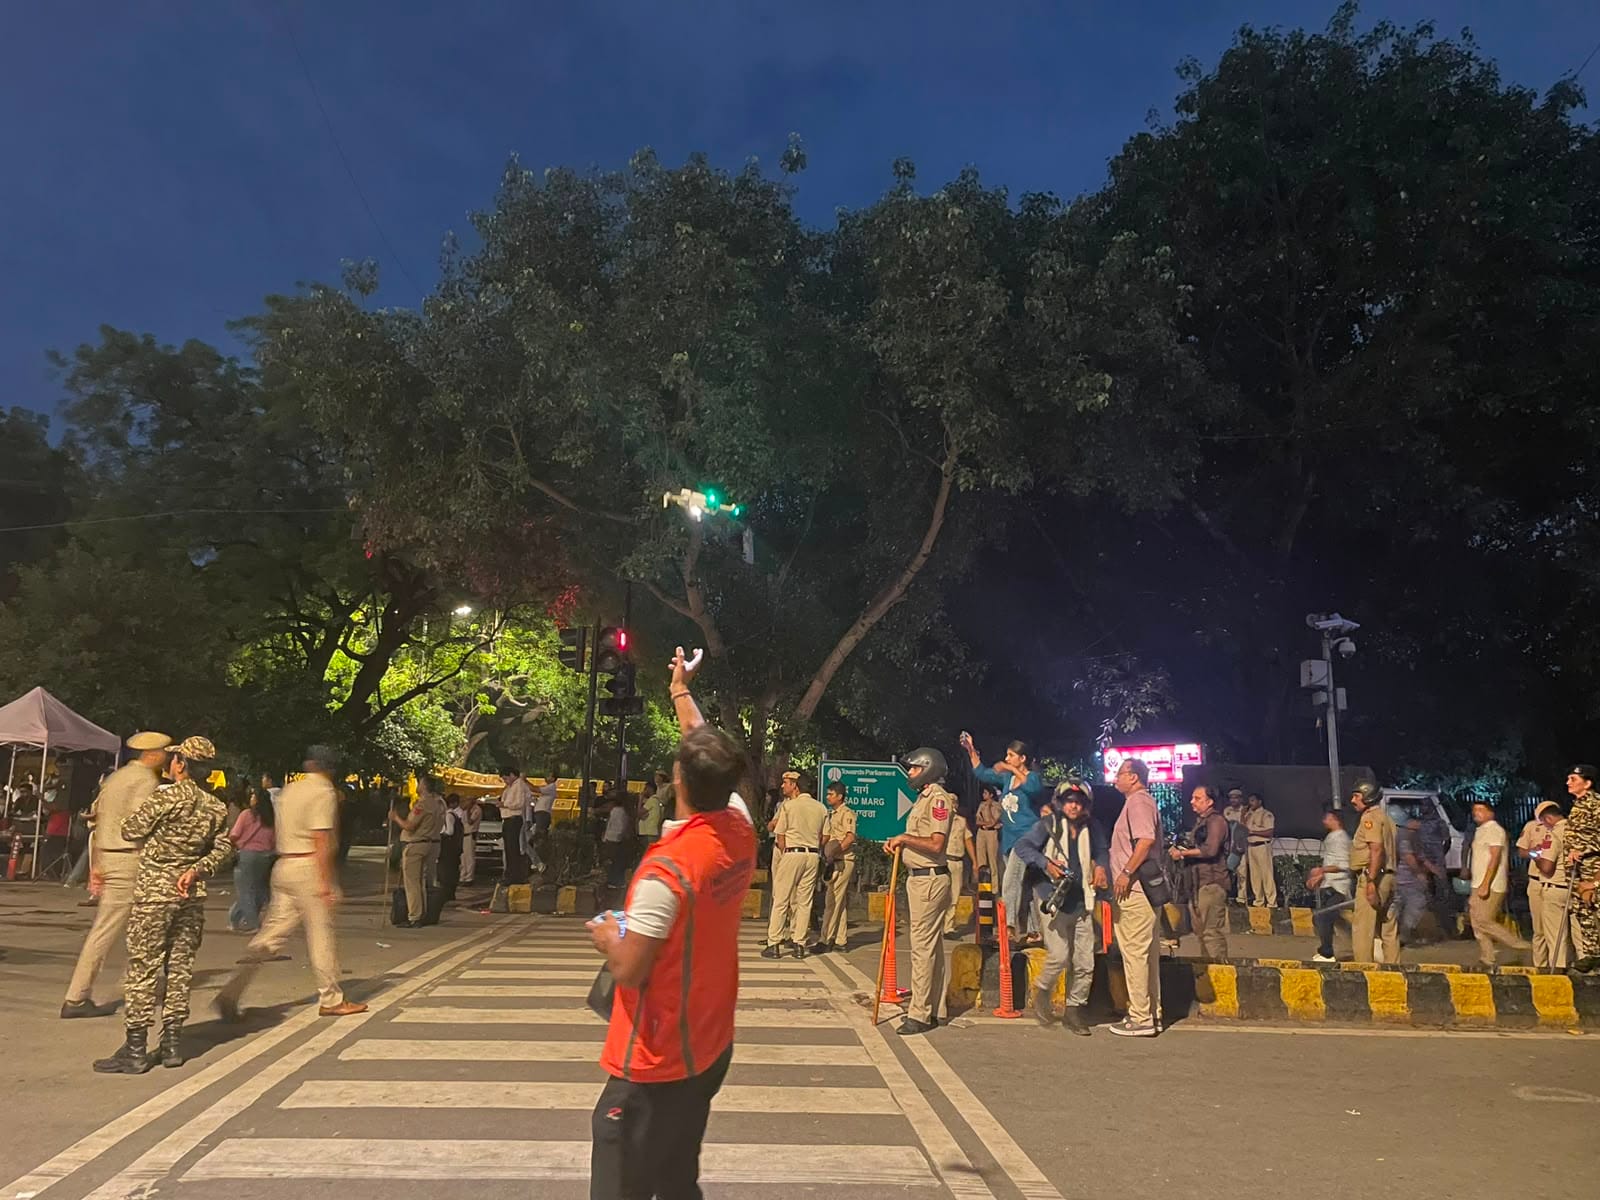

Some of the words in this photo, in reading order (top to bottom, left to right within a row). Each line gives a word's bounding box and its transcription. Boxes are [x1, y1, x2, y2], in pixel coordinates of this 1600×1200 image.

[865, 769, 896, 777] Parliament
[853, 784, 869, 794] मार्ग
[861, 797, 885, 806] MARG
